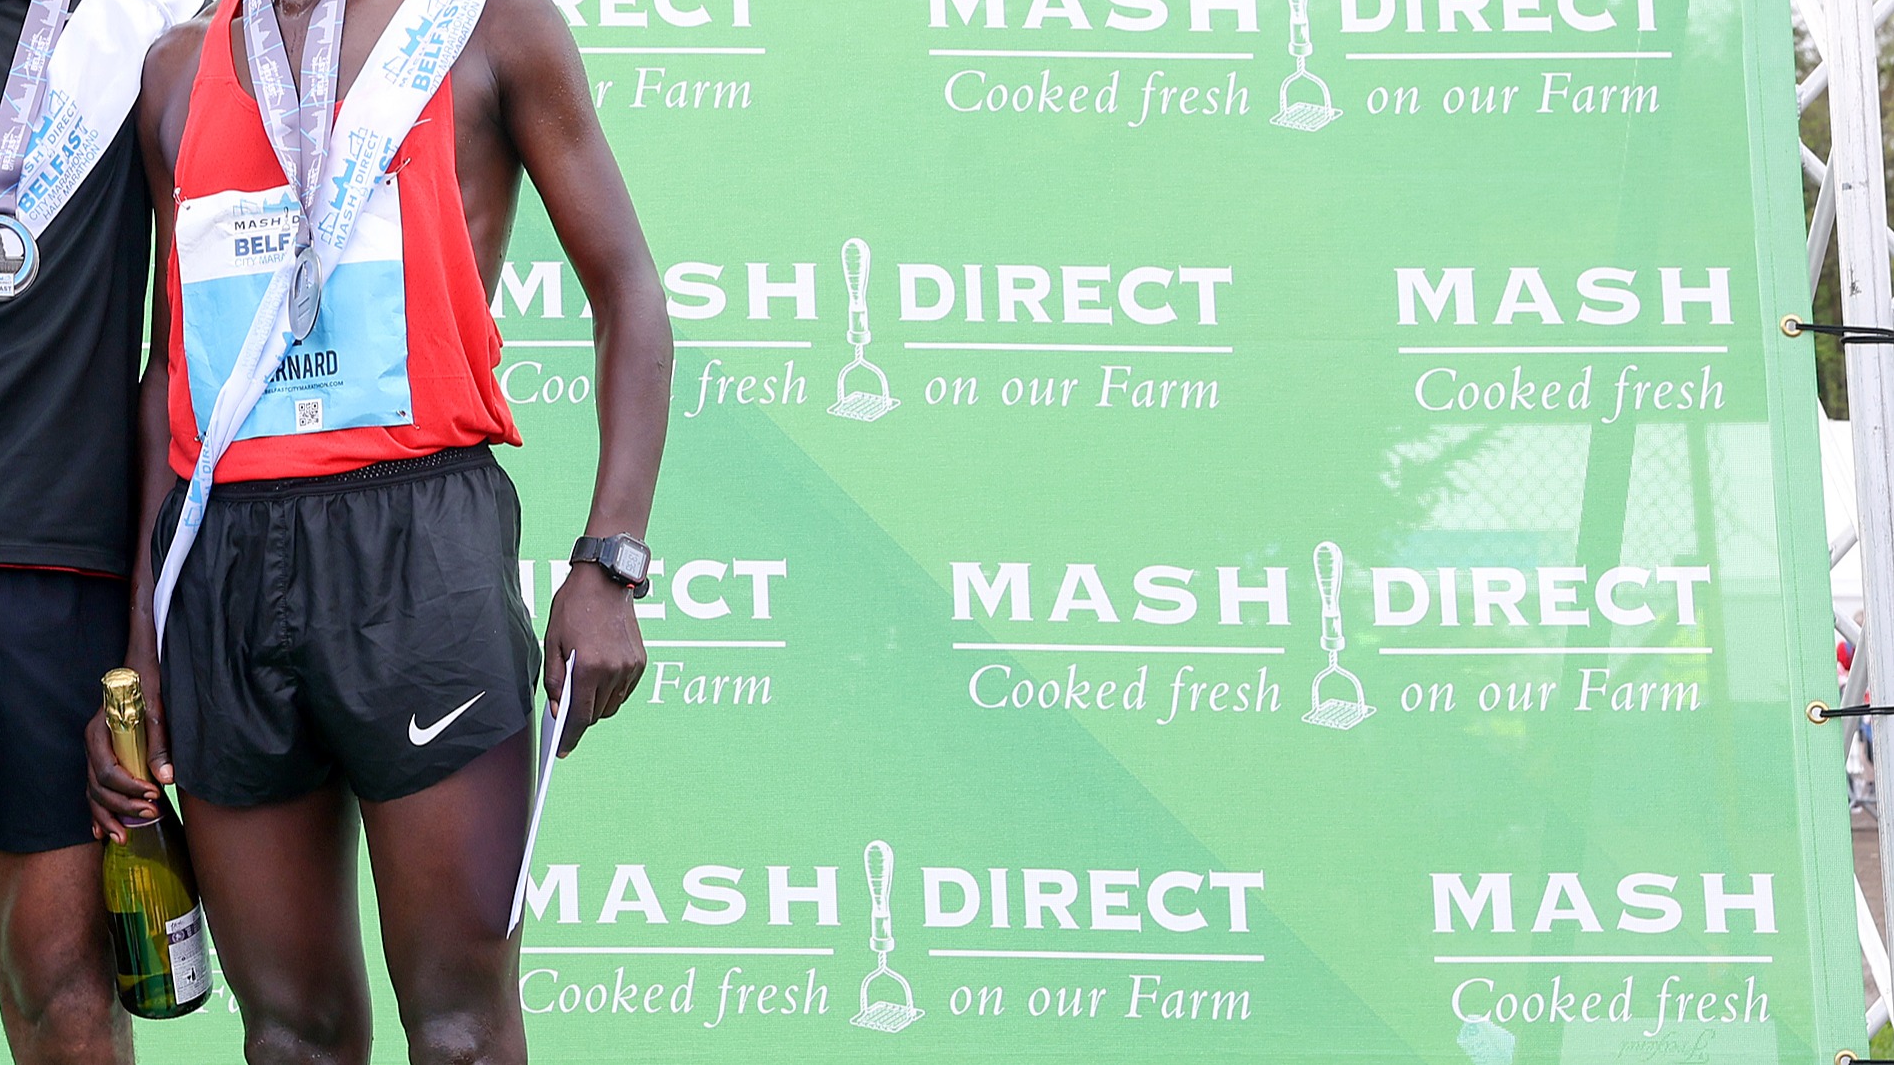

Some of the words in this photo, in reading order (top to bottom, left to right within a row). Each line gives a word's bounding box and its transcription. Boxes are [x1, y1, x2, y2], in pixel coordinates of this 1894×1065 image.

[631, 67, 751, 108] Farm
[944, 69, 1119, 113] Cooked
[1128, 70, 1249, 127] fresh
[1367, 87, 1419, 114] on
[1443, 86, 1519, 114] our
[1538, 72, 1658, 113] Farm
[48, 101, 78, 145] DIRECT
[18, 116, 88, 213] BELFAST
[29, 196, 50, 221] CITY
[48, 154, 86, 205] MARATHON
[79, 129, 99, 153] AND
[42, 197, 65, 220] HALF
[61, 145, 101, 200] MARATHON
[234, 218, 281, 231] MASH
[234, 233, 297, 257] BELF
[334, 192, 358, 249] MASH
[898, 264, 1232, 325] DIRECT
[1395, 267, 1732, 325] MASH
[684, 358, 808, 418] fresh
[925, 377, 977, 405] on
[1001, 378, 1078, 406] our
[1097, 365, 1218, 408] Farm
[1415, 365, 1592, 410] Cooked
[1602, 364, 1724, 423] fresh
[950, 562, 1290, 625] MASH
[1374, 566, 1711, 625] DIRECT
[649, 662, 771, 704] Farm
[969, 663, 1148, 710] Cooked
[1157, 665, 1280, 725] fresh
[1401, 683, 1455, 712] on
[1479, 681, 1557, 711] our
[1576, 667, 1701, 711] Farm
[922, 867, 1264, 932] DIRECT
[1431, 872, 1778, 933] MASH
[519, 967, 696, 1013] Cooked
[703, 967, 828, 1028] fresh
[950, 986, 1003, 1015] on
[1028, 987, 1107, 1017] our
[1126, 975, 1250, 1020] Farm
[1451, 975, 1633, 1023] Cooked
[1643, 975, 1770, 1037] fresh
